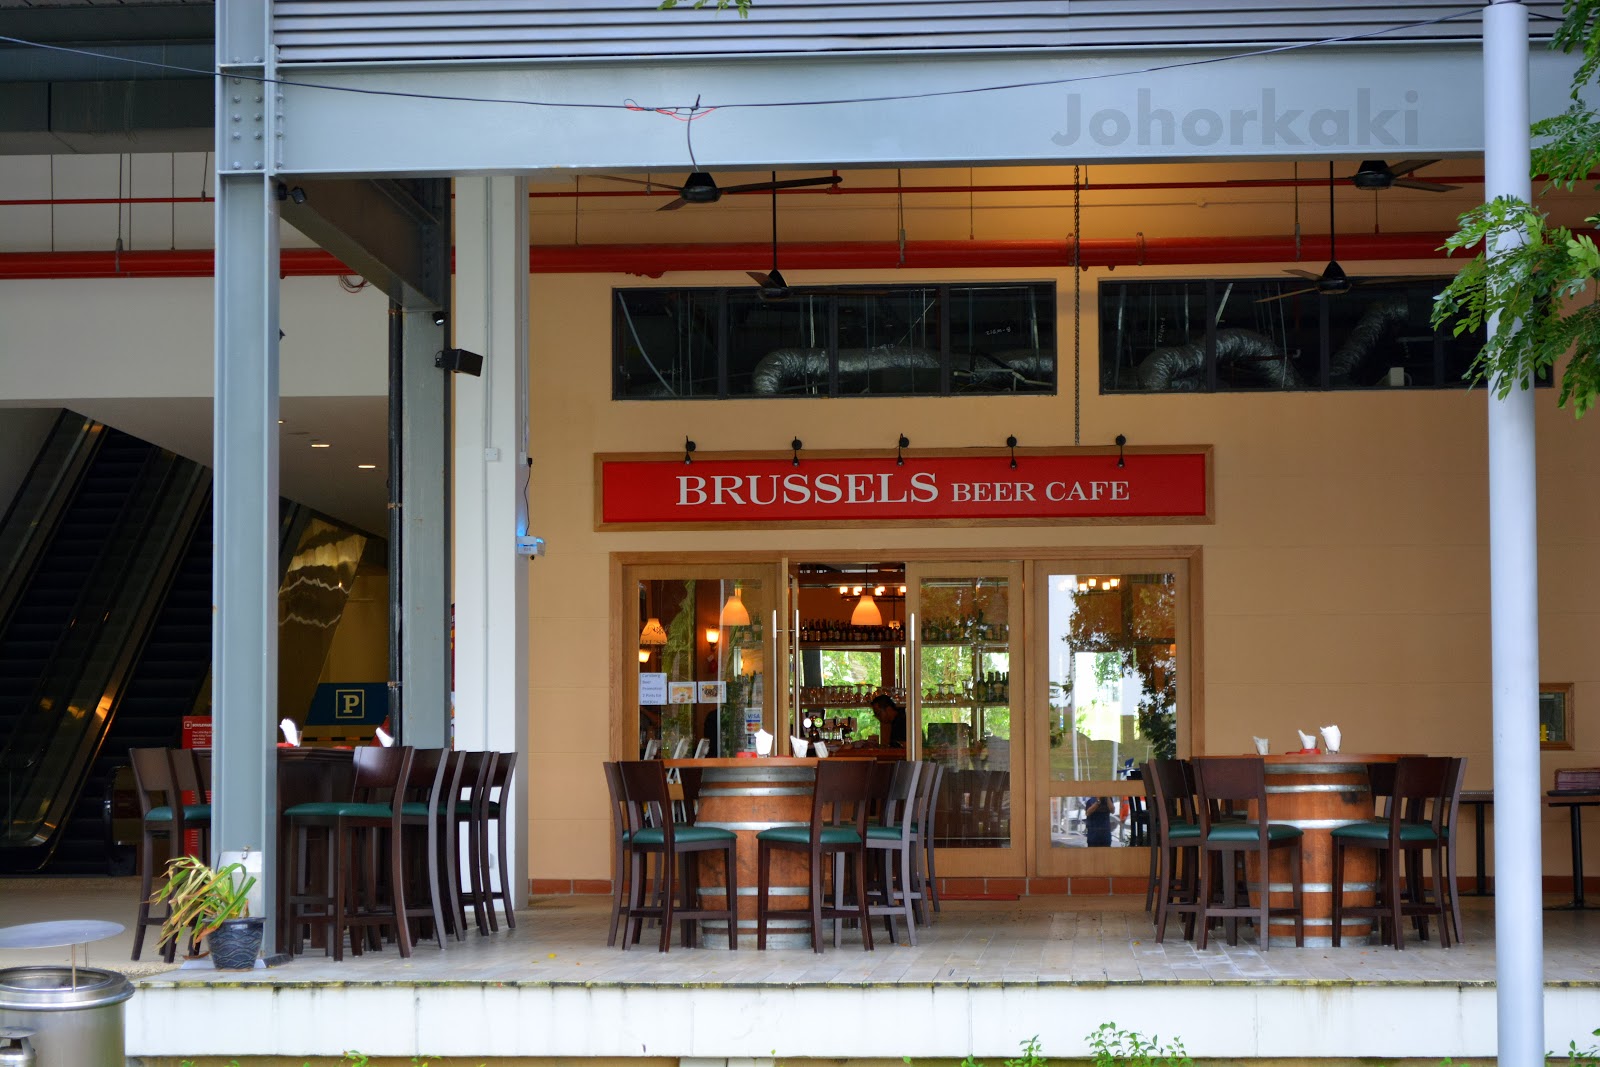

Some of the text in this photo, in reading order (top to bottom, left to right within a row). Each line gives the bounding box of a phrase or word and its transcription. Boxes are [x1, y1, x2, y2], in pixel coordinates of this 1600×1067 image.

[676, 472, 1130, 506] BRUSSELS BEER CAFE
[343, 694, 360, 713] P
